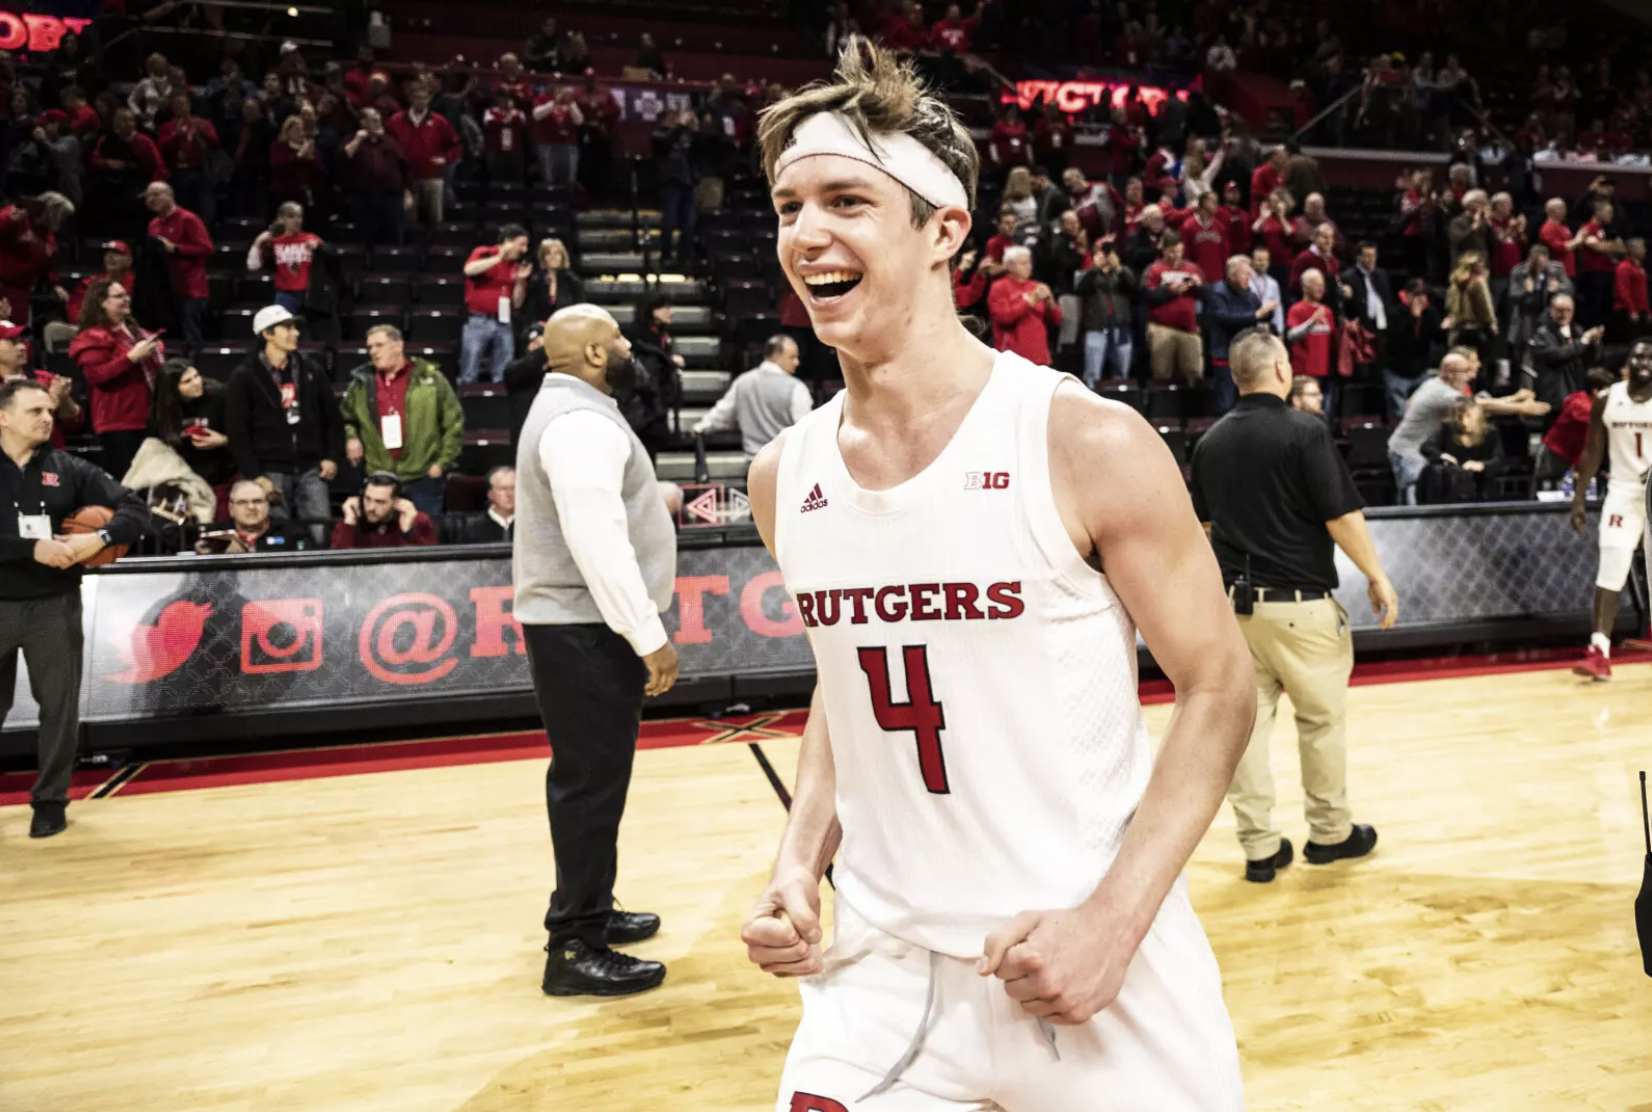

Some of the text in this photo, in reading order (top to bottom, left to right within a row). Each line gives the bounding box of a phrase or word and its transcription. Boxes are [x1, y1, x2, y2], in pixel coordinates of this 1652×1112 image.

[1634, 432, 1643, 458] 1
[42, 471, 60, 487] R
[800, 499, 828, 513] adidas
[1609, 514, 1623, 528] R
[796, 581, 1025, 628] RUTGERS
[856, 644, 951, 795] 4
